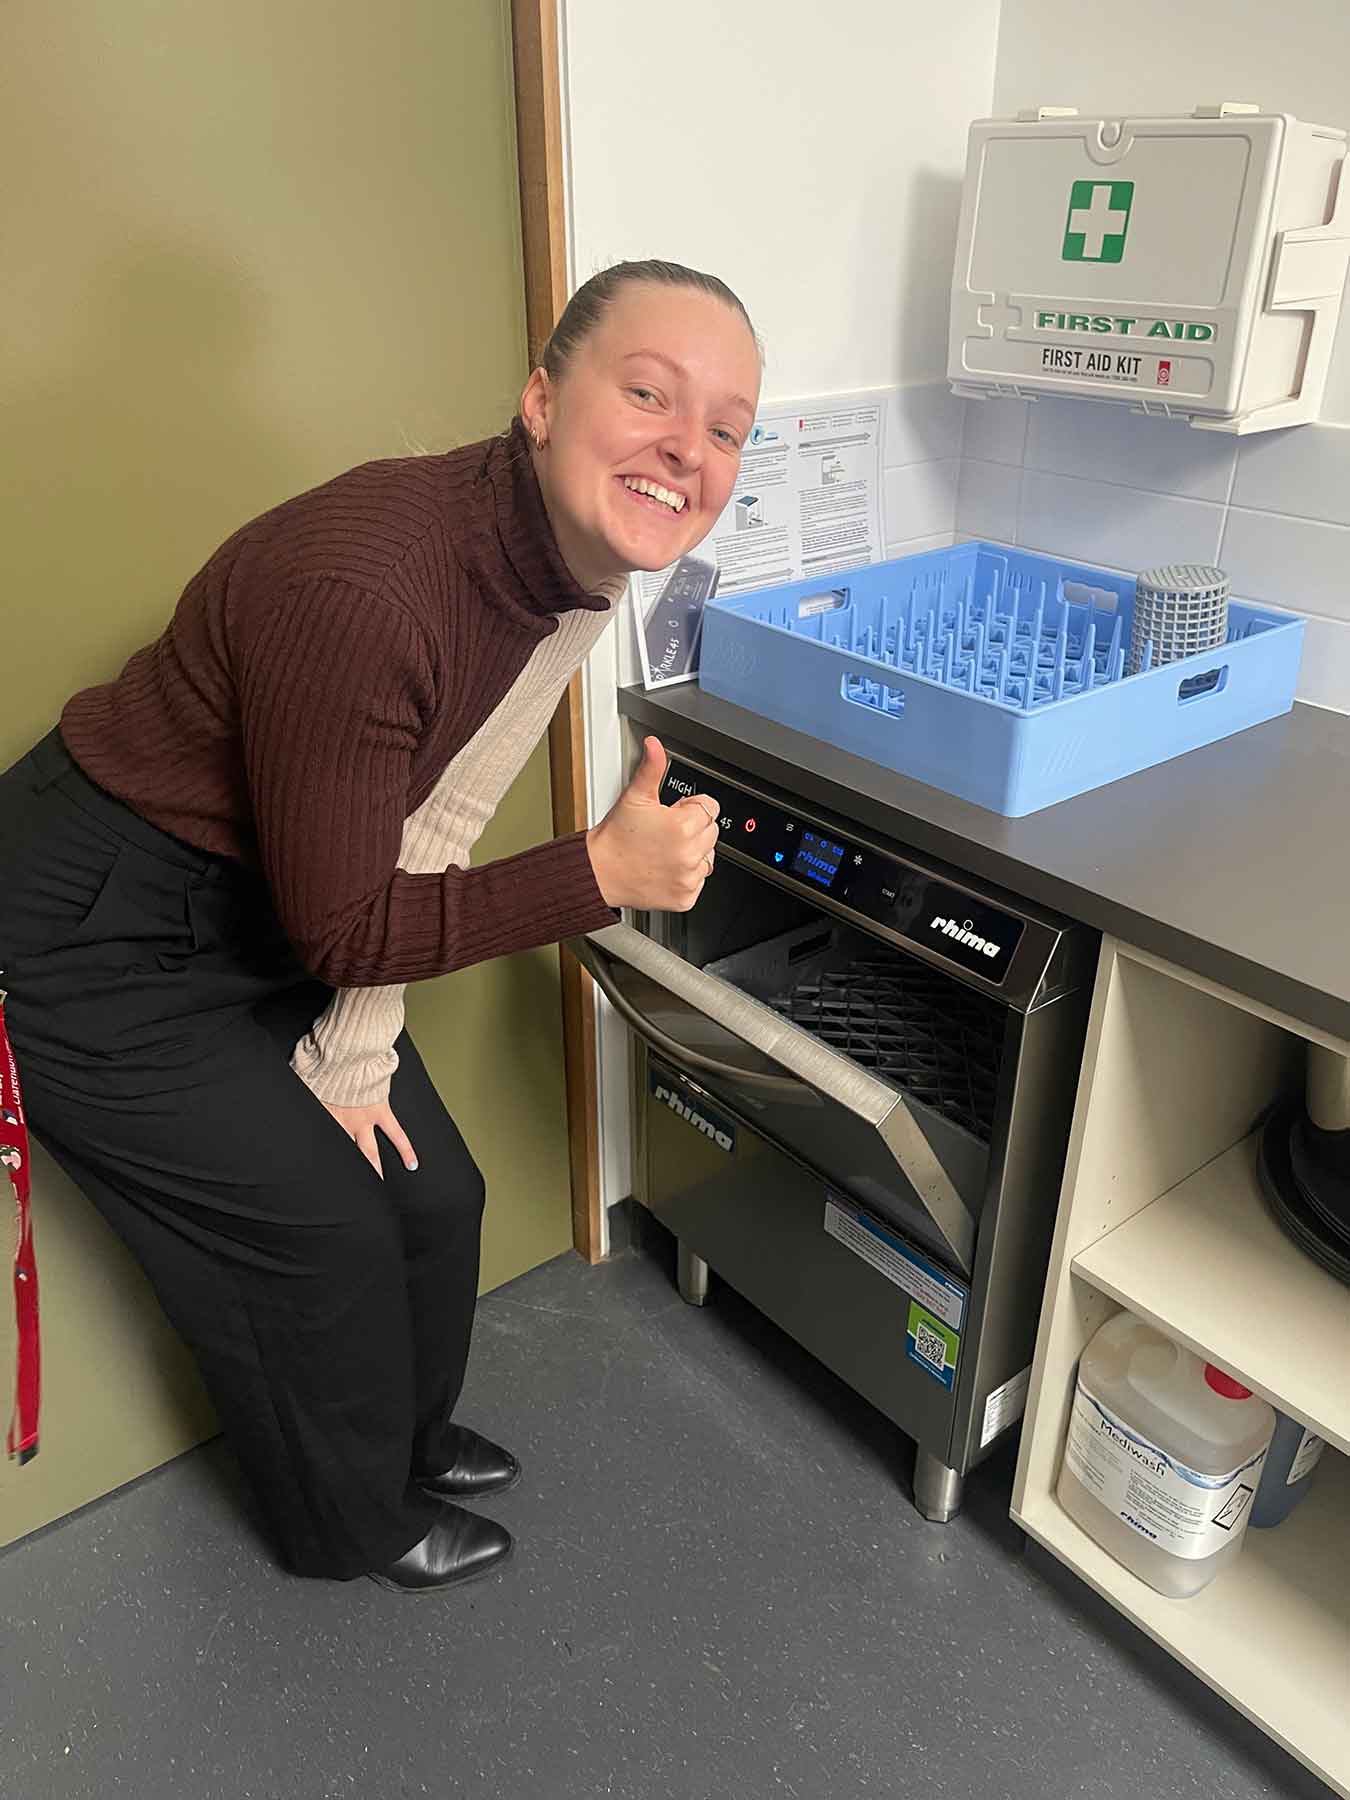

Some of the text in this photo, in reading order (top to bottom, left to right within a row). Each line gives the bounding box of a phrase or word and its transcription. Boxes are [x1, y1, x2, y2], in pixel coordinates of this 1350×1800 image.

[1038, 312, 1213, 341] FIRST AID
[1042, 348, 1083, 369] FIRST
[1086, 353, 1111, 372] AID
[1116, 357, 1142, 375] KIT
[667, 776, 692, 796] HIGH
[798, 849, 838, 875] rhima
[930, 916, 1001, 958] rhima
[655, 1085, 733, 1151] rhima
[1100, 1419, 1167, 1477] Mediwash
[1120, 1510, 1157, 1539] rhima
